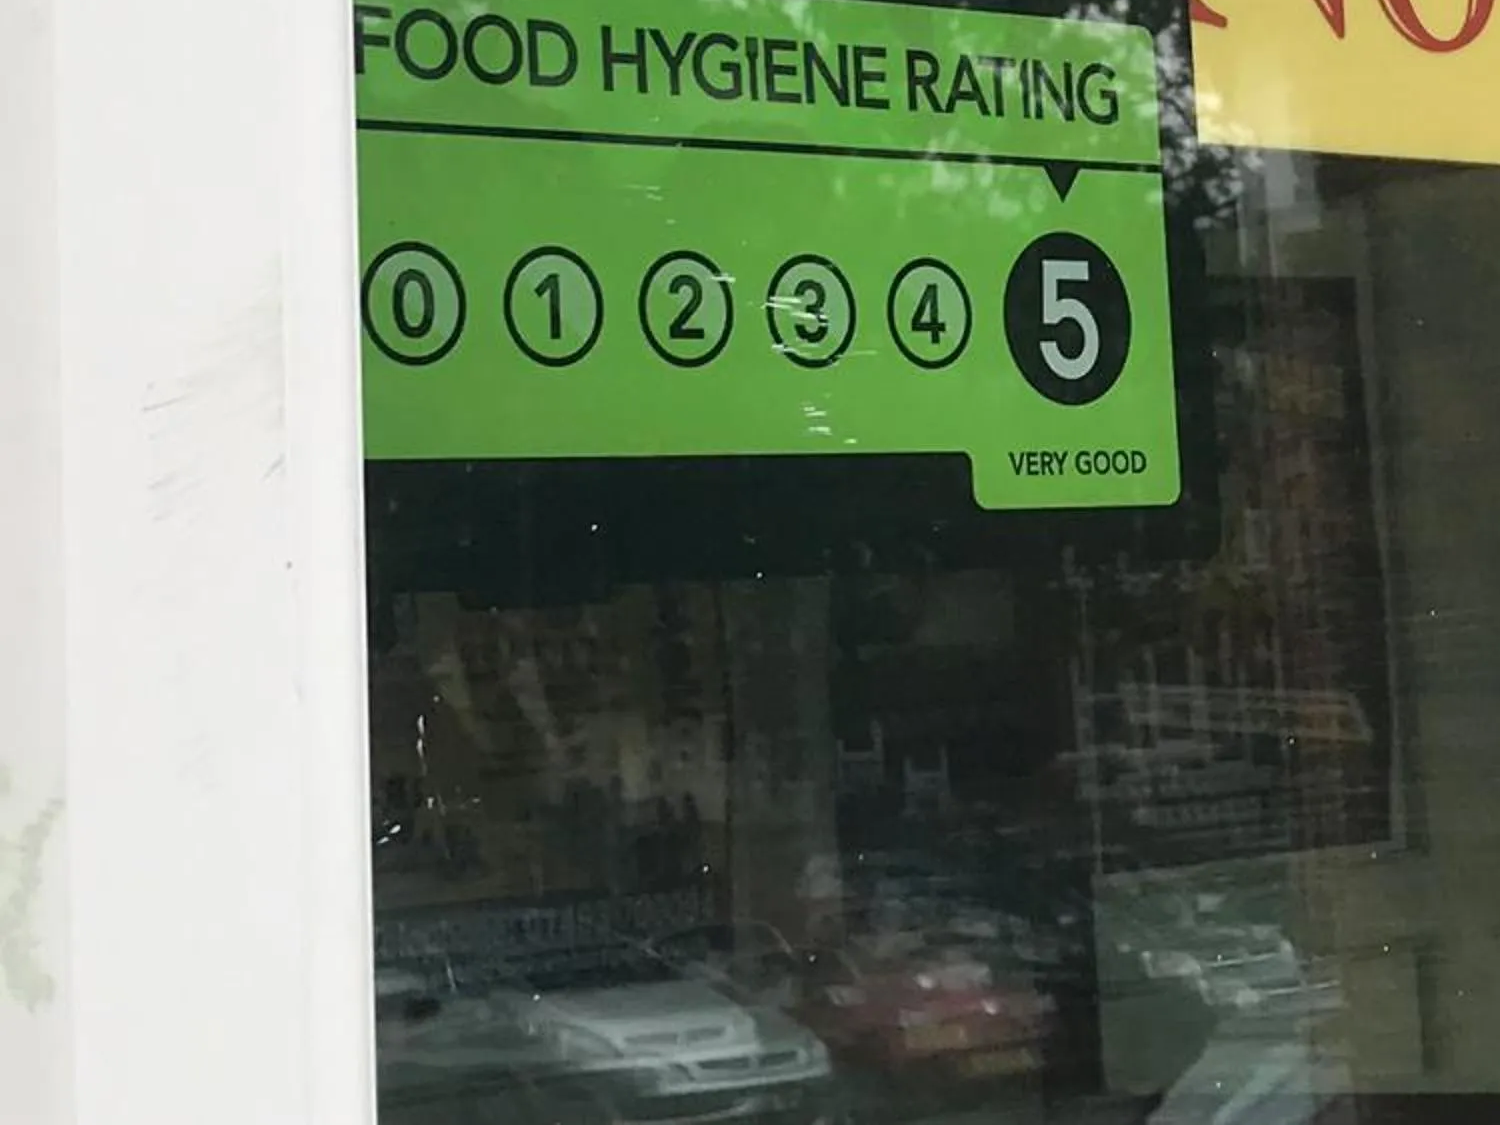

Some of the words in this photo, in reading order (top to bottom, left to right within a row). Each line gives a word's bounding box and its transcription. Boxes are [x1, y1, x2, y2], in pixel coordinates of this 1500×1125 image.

[354, 4, 579, 88] FOOD
[601, 24, 891, 111] HYGIENE
[904, 47, 1121, 127] RATING
[392, 269, 436, 339] 0
[534, 272, 561, 340] 1
[667, 274, 705, 340] 2
[794, 279, 828, 344] 3
[910, 283, 946, 345] 4
[1039, 259, 1100, 381] 5
[1007, 450, 1069, 476] VERY
[1075, 449, 1148, 476] GOOD
